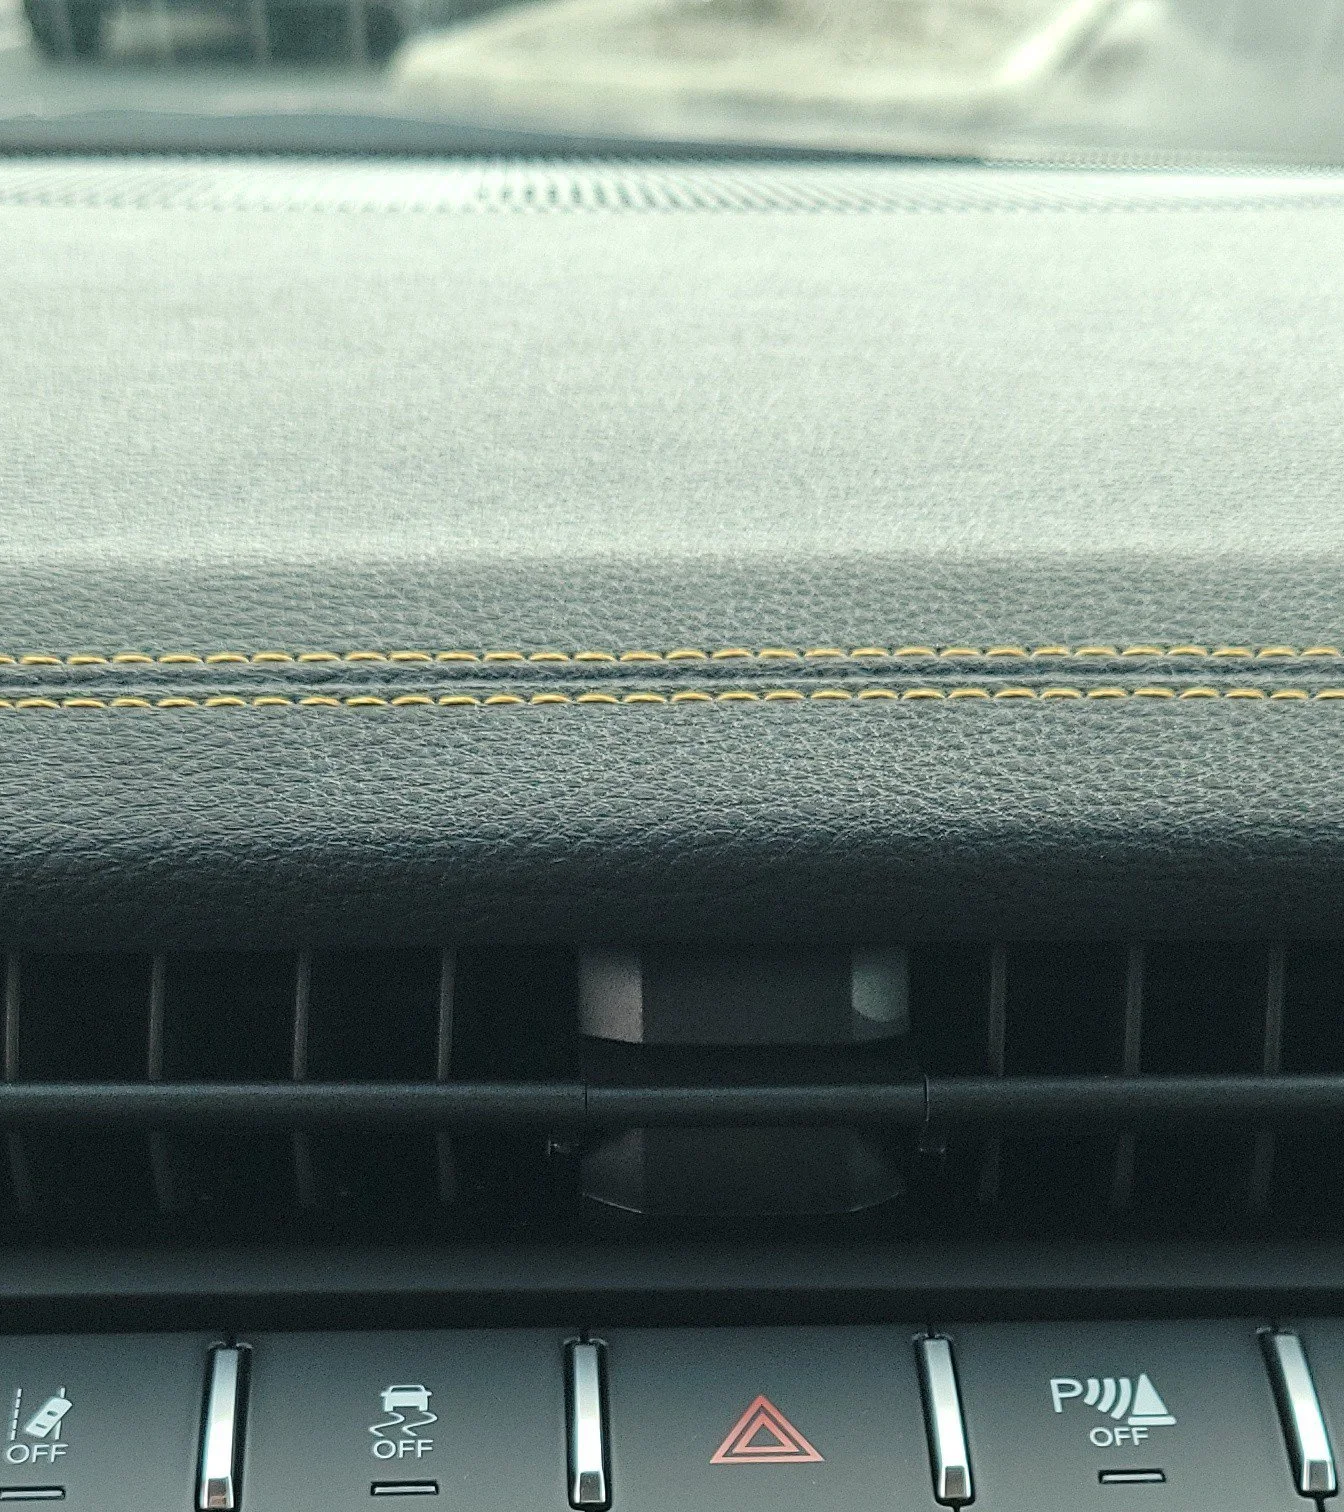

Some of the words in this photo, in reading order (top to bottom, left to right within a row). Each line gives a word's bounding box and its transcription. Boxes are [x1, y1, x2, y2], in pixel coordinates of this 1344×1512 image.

[1089, 1427, 1150, 1447] OFF
[6, 1443, 68, 1464] OFF
[373, 1438, 434, 1460] OFF
